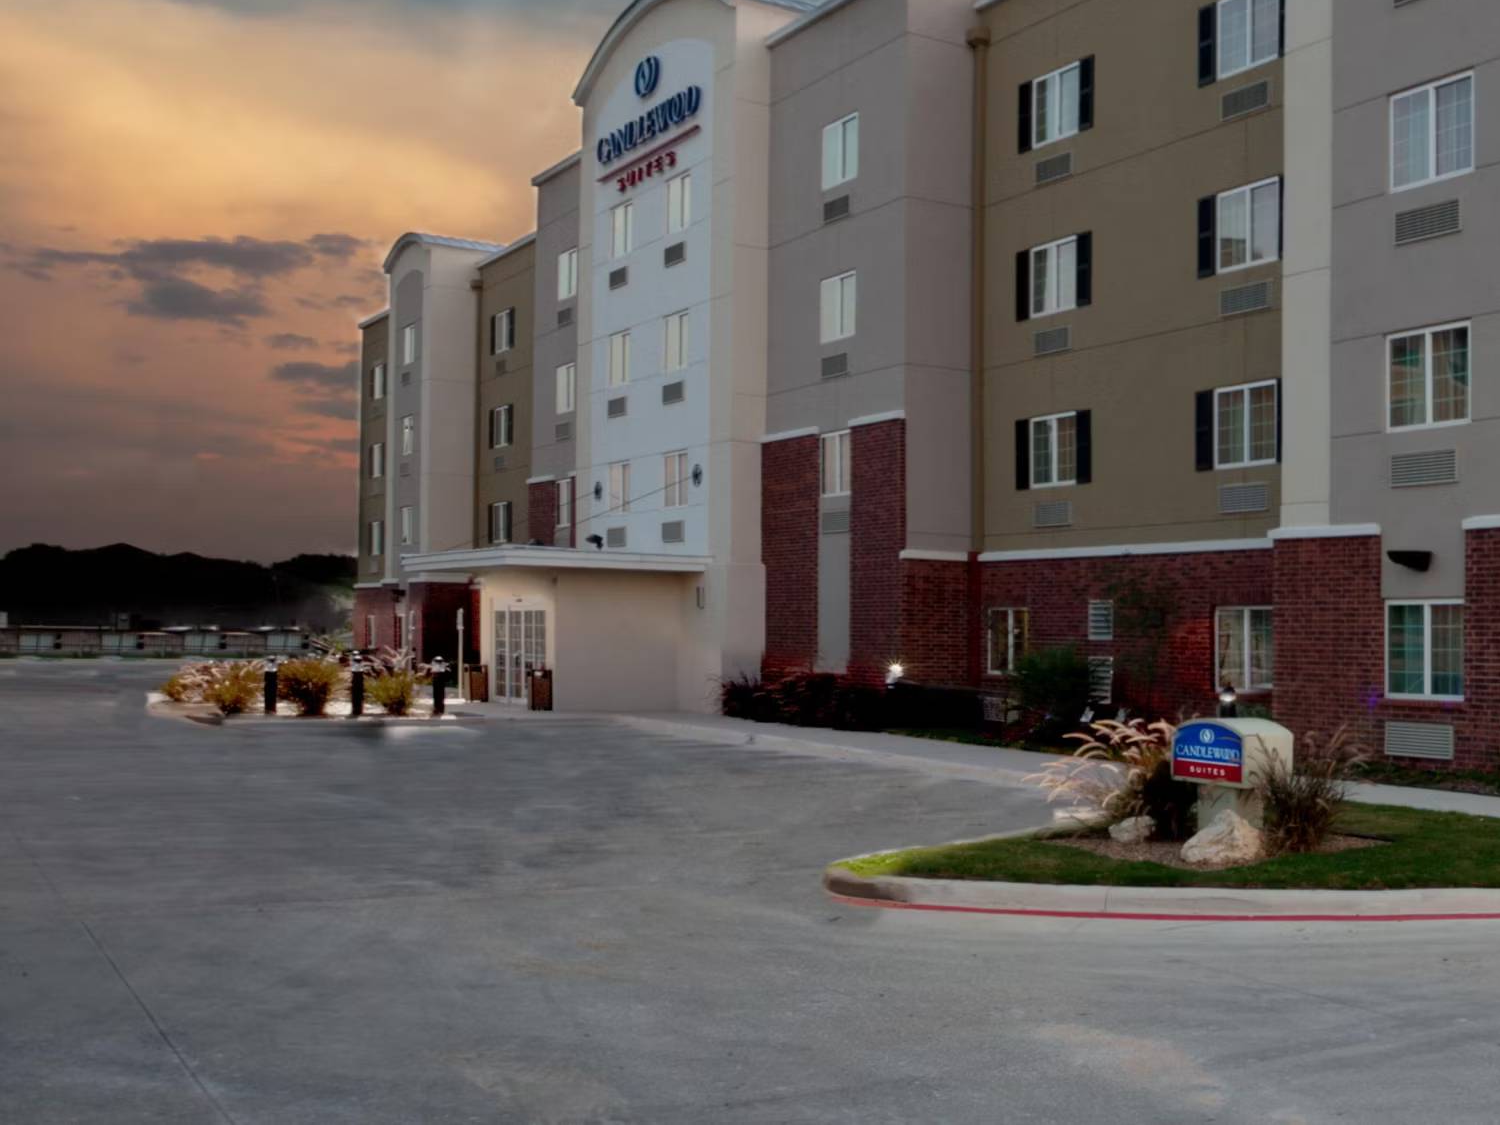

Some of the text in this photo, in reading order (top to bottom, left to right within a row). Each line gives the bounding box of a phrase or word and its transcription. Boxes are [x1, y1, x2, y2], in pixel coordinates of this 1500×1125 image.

[597, 85, 702, 164] CANDLEWOOD
[617, 151, 677, 192] SUITES
[1175, 744, 1240, 761] CANDLEWOOD
[1190, 765, 1226, 776] SUITES
